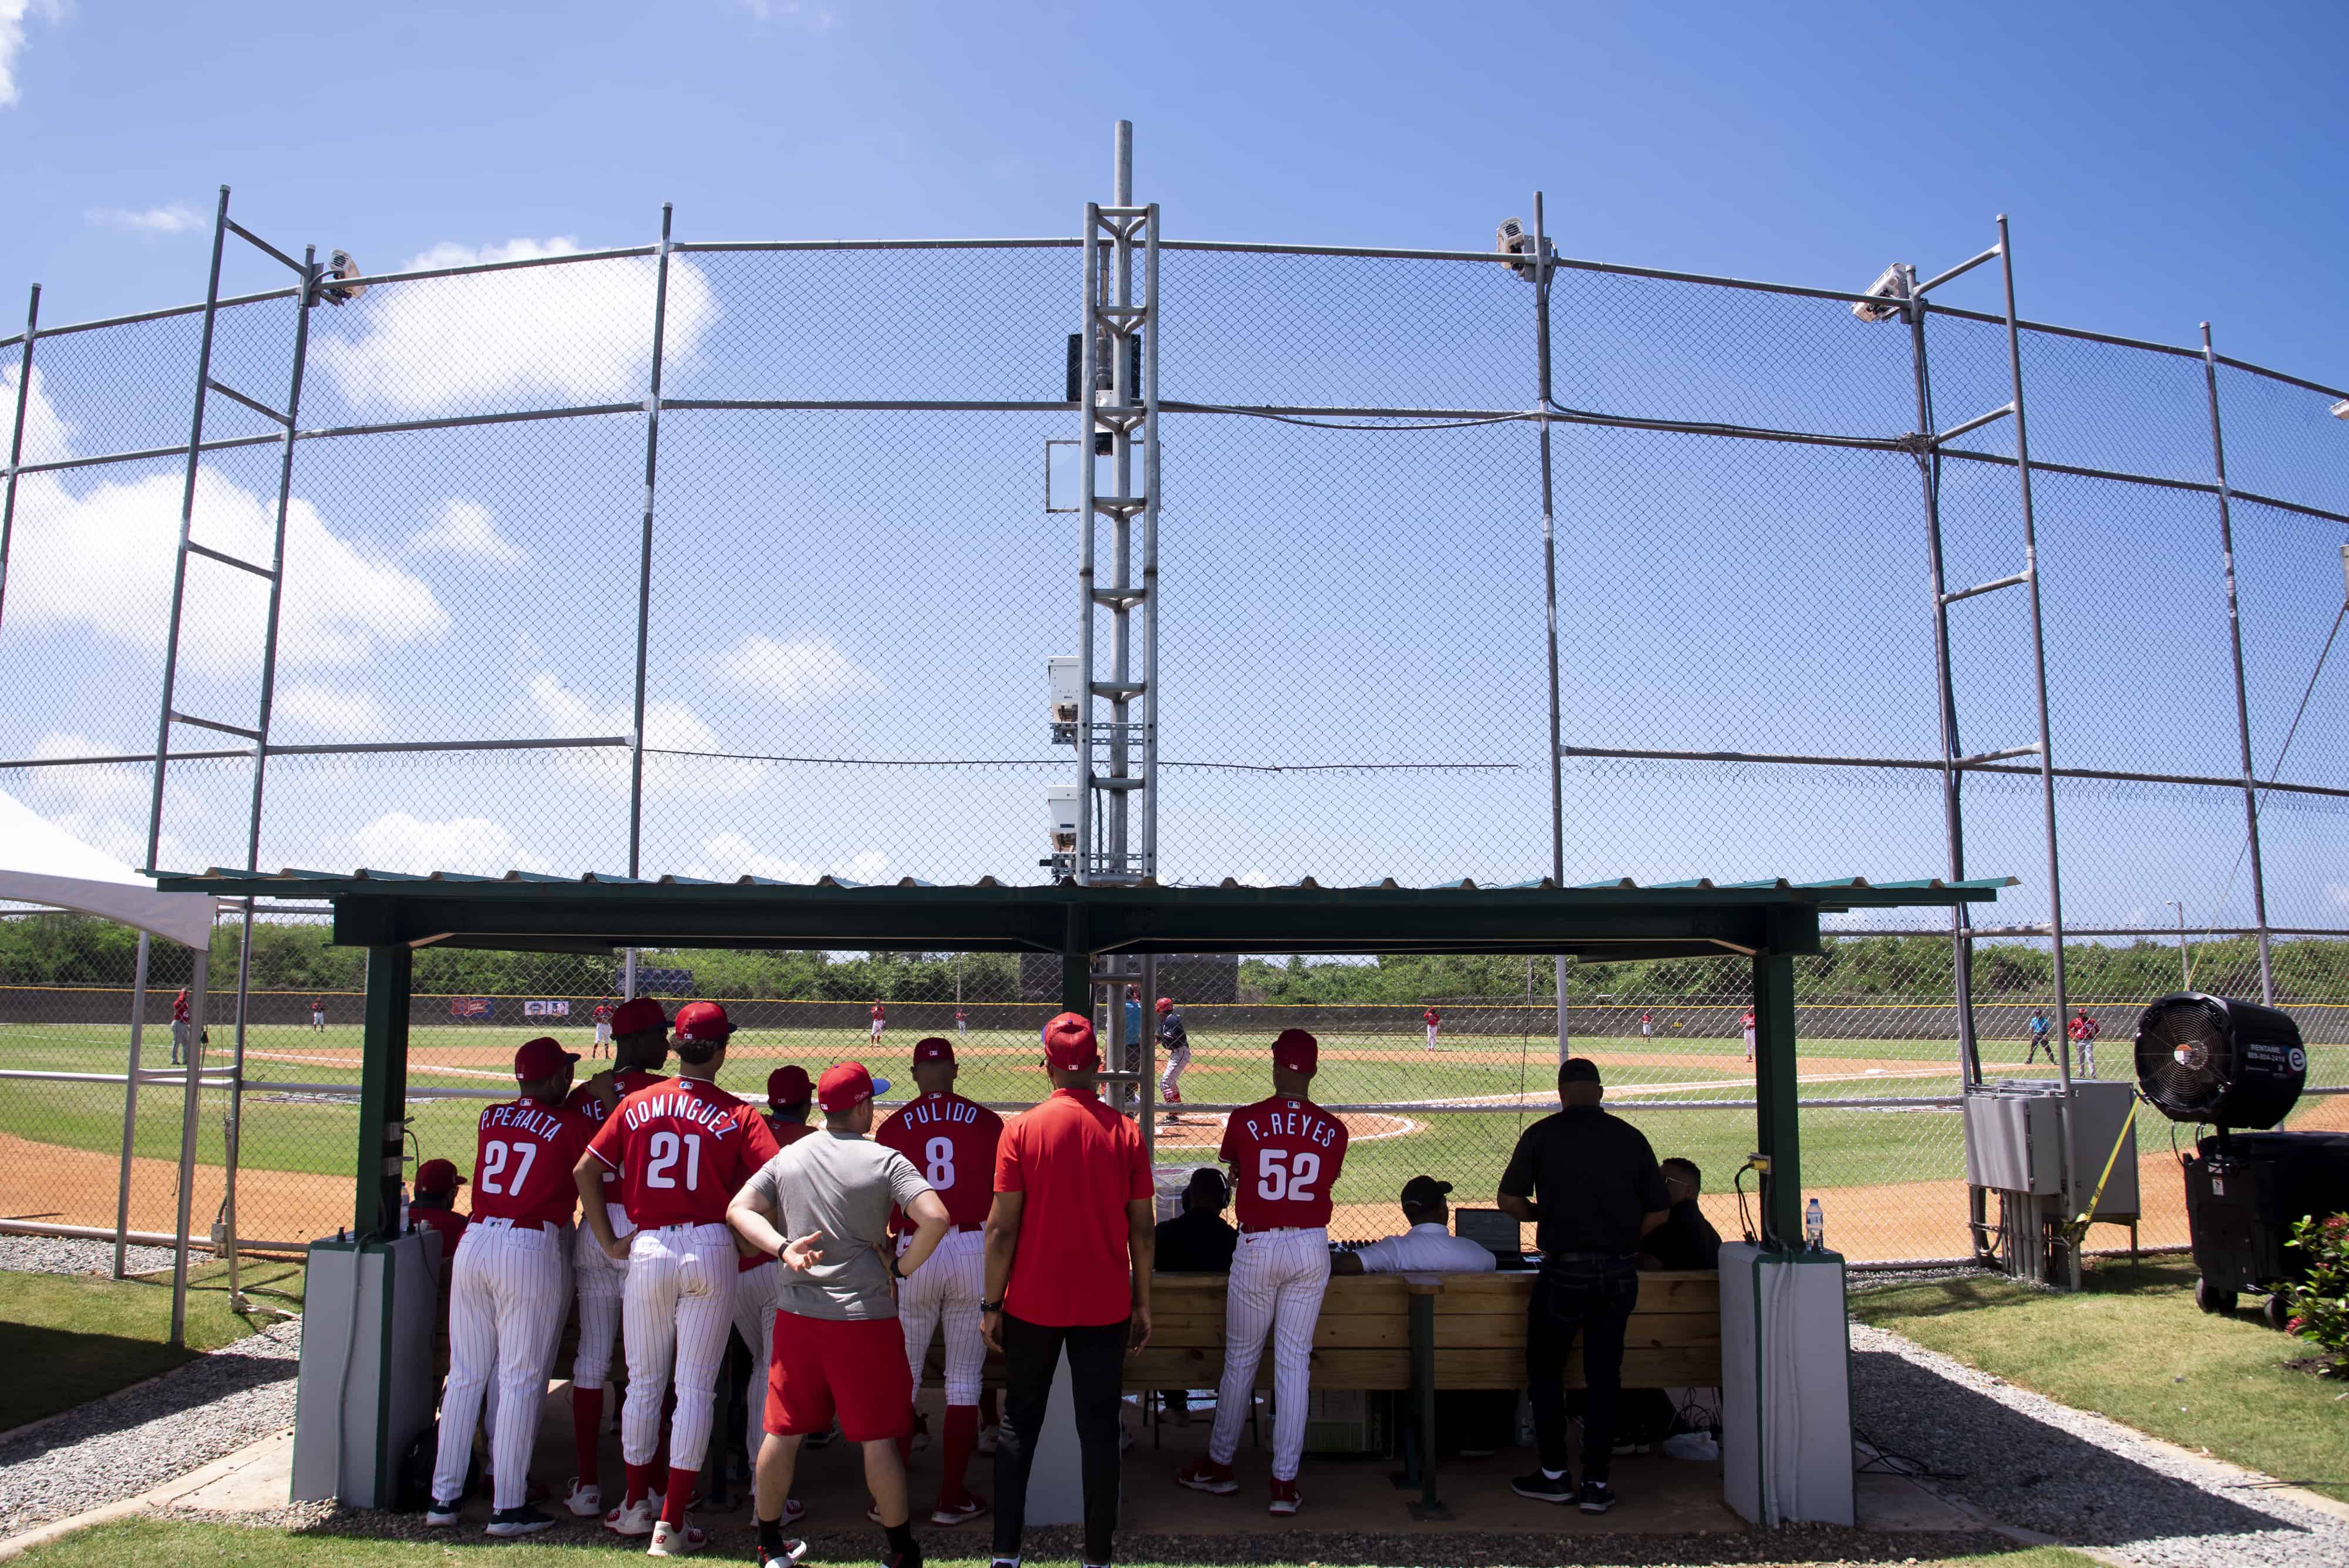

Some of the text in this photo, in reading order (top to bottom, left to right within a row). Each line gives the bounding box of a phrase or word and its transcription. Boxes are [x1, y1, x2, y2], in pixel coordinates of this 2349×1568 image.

[481, 1106, 563, 1142] P.PERALTA
[625, 1093, 739, 1141] DOMINGUEZ
[903, 1102, 977, 1130] PULIDO
[1247, 1113, 1335, 1148] P.REYES
[482, 1140, 537, 1197] 27
[647, 1131, 701, 1192] 21
[926, 1136, 955, 1190] 8
[1258, 1149, 1320, 1202] 52
